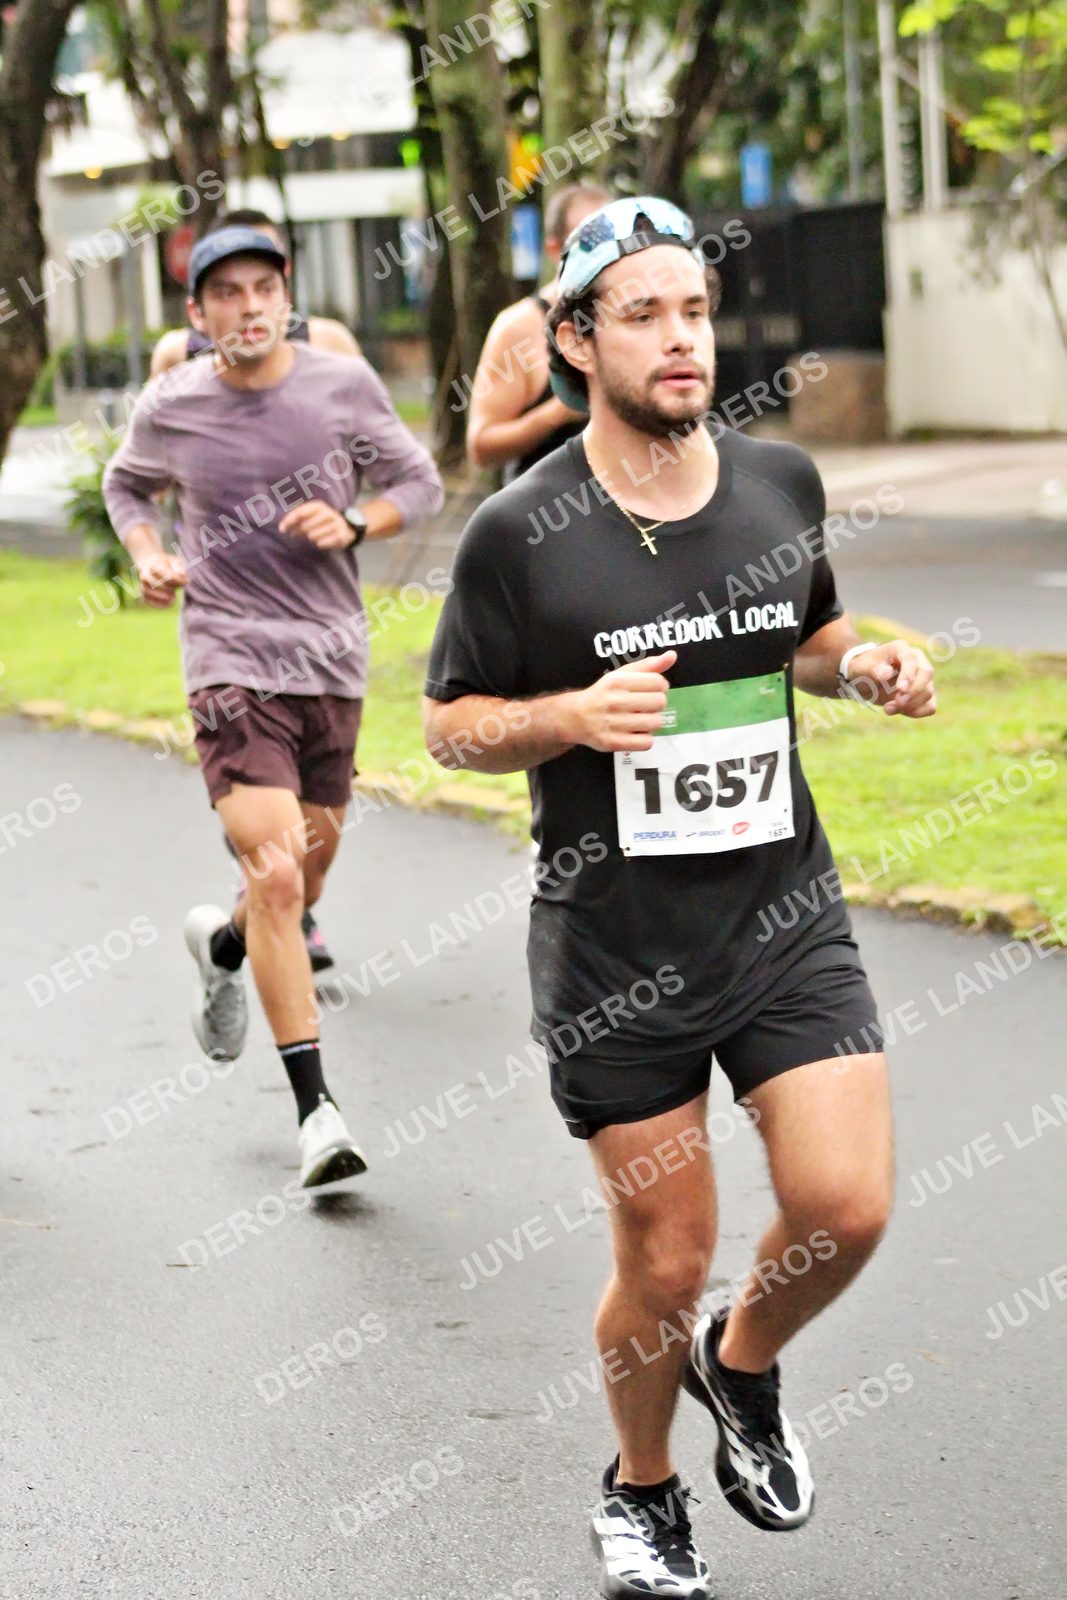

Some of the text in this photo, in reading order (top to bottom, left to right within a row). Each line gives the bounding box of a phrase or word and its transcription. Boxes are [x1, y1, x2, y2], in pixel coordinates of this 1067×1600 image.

[593, 600, 798, 658] CORREDOR LOCAL
[634, 751, 779, 815] 1657
